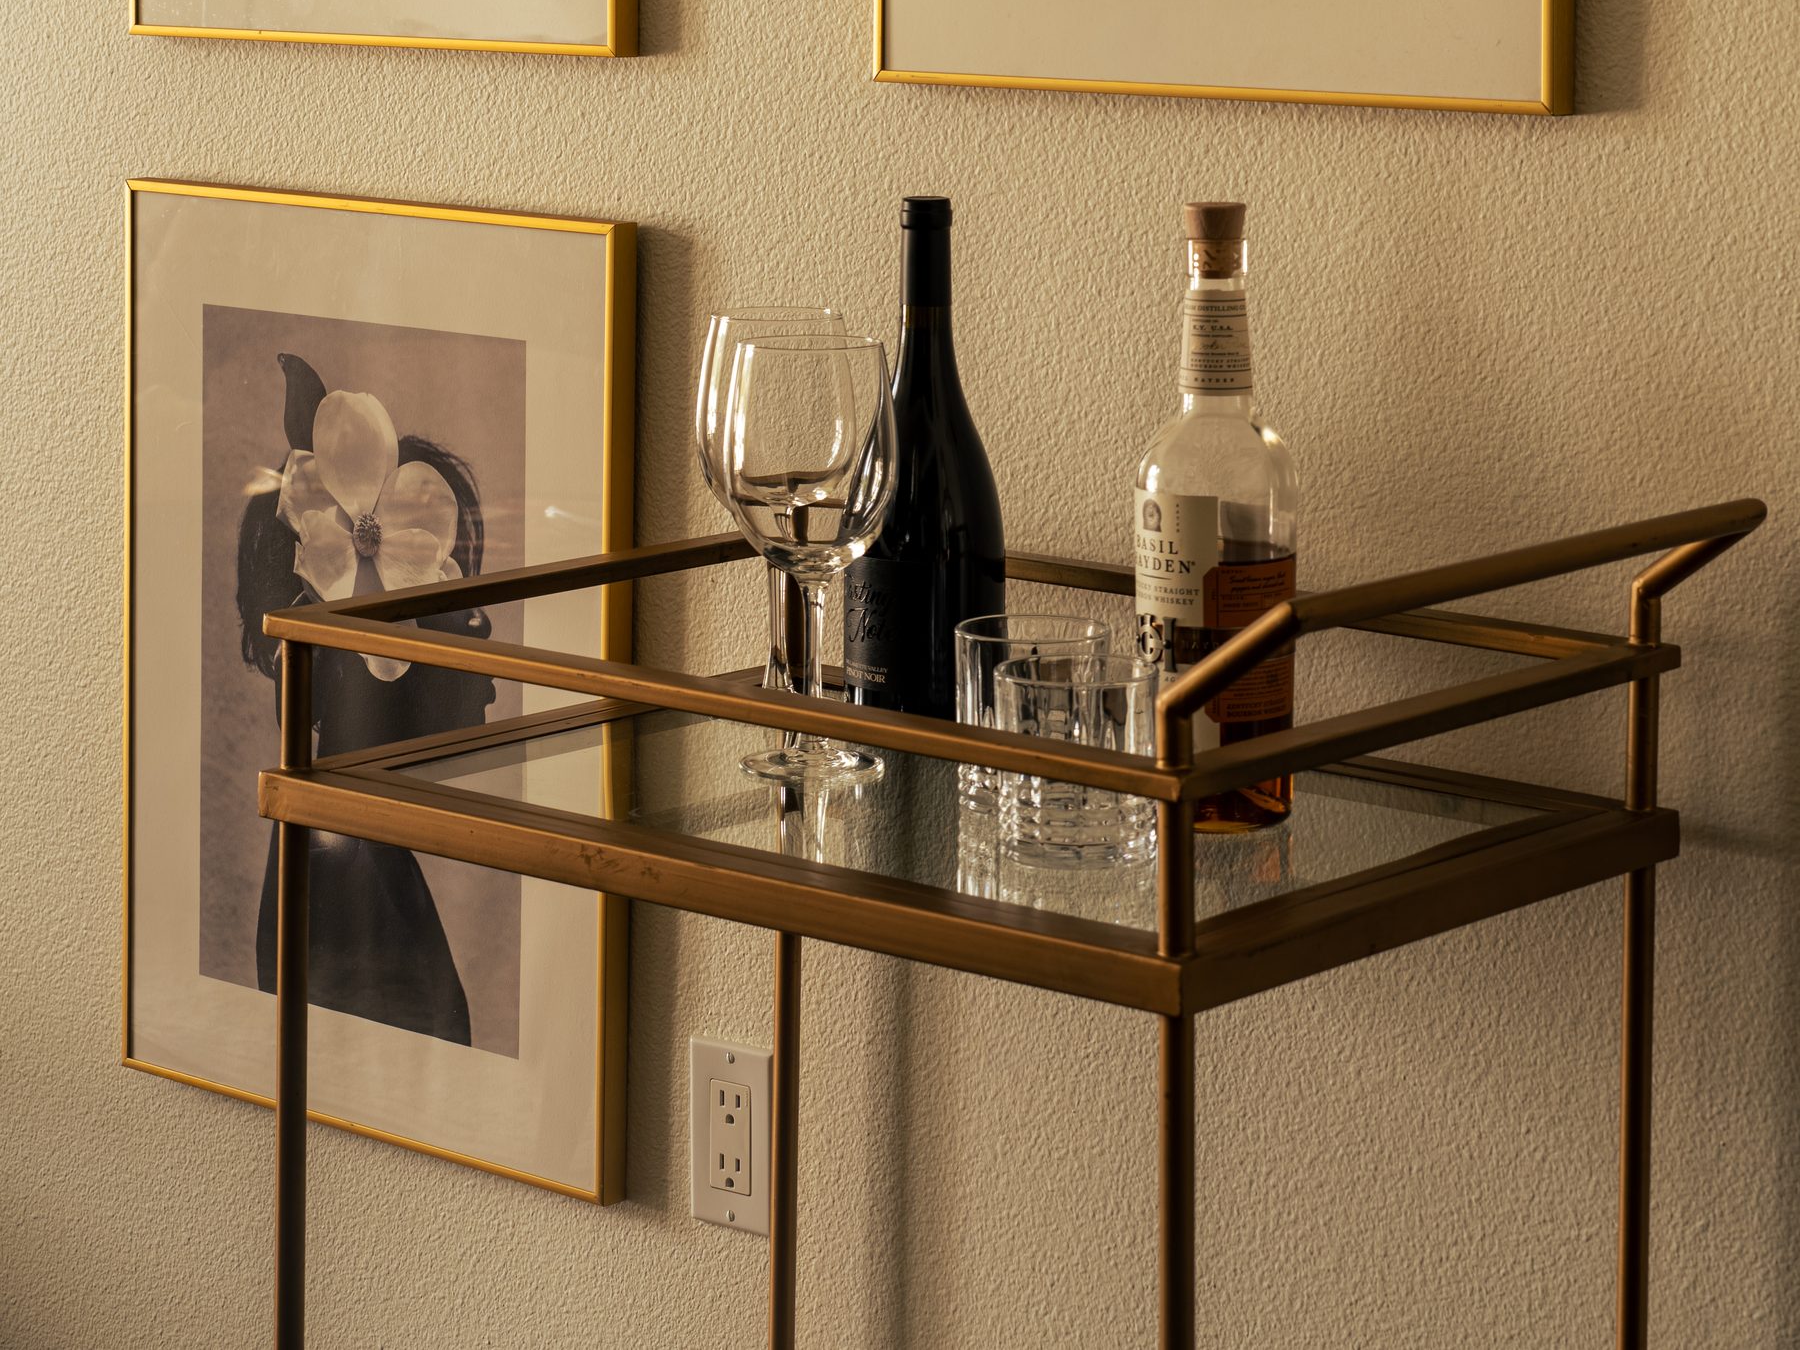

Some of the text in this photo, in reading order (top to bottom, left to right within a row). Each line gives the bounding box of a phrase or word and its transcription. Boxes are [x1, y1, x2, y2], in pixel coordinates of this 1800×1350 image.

[1136, 534, 1179, 555] BASIL
[1154, 585, 1201, 597] STRAIGHT
[1154, 595, 1195, 606] WHISKEY
[846, 666, 886, 684] PINOT NOIR
